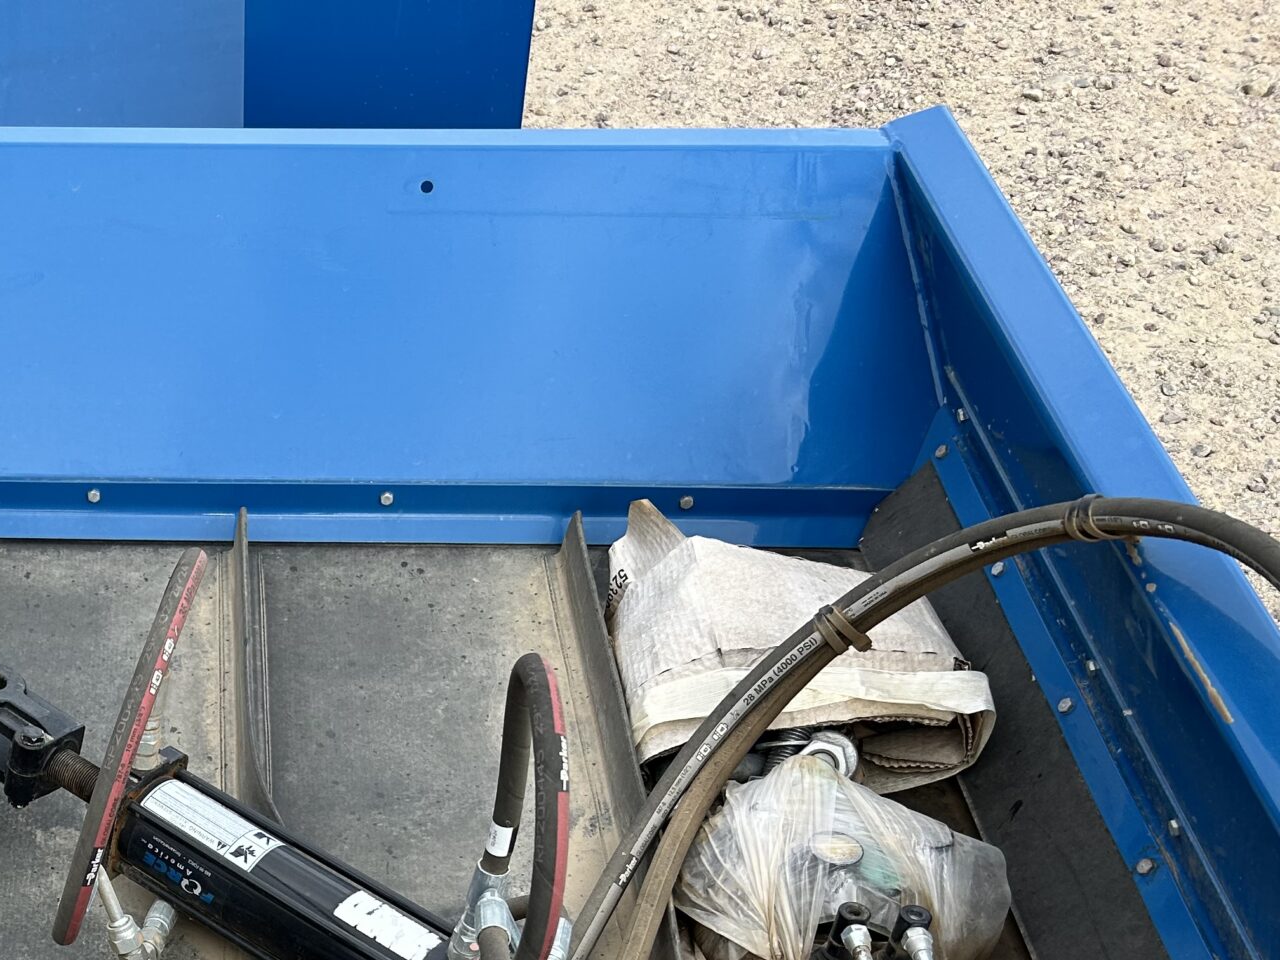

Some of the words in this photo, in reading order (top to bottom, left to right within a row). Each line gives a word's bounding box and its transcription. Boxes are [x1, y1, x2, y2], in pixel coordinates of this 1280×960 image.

[742, 693, 756, 707] 28
[755, 675, 774, 695] MPa
[773, 653, 798, 677] (4000
[796, 637, 818, 656] PSI)
[559, 735, 569, 791] Parker
[86, 849, 104, 886] Parker
[618, 856, 638, 886] Parker
